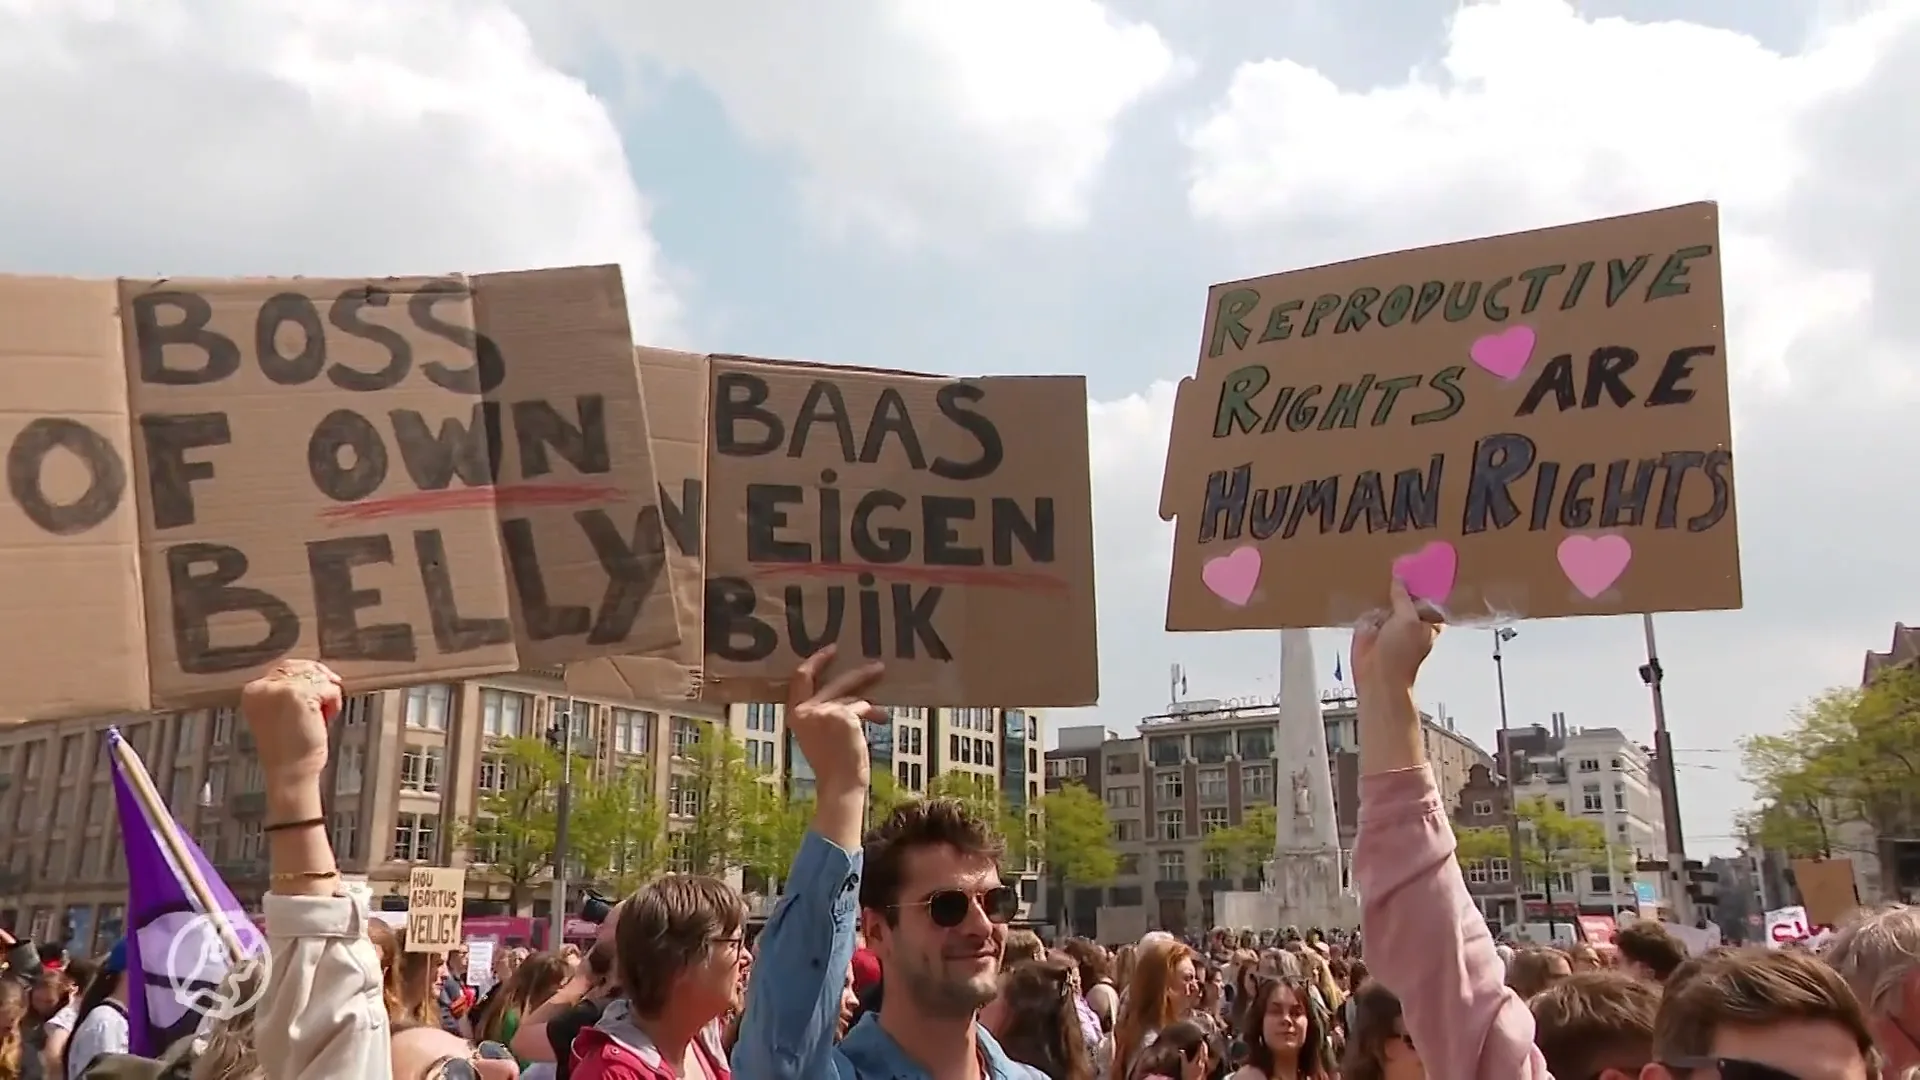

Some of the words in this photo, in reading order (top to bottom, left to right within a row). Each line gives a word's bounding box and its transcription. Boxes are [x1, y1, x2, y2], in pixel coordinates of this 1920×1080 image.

[133, 280, 505, 394] BOSS
[1208, 245, 1712, 359] REPRODUCTIVE
[716, 372, 1003, 480] BAAS
[1213, 364, 1465, 438] RIGHTS
[1514, 344, 1715, 417] ARE
[8, 411, 231, 535] OF
[308, 394, 610, 501] OWN
[1199, 453, 1444, 543] HUMAN
[1463, 433, 1732, 536] RIGHTS
[746, 468, 1054, 566] EIGEN
[166, 504, 666, 674] BELLY
[705, 572, 953, 662] BUIK
[410, 914, 459, 944] VEILIG!
[411, 890, 457, 908] ABORTUS
[412, 872, 434, 888] HOU
